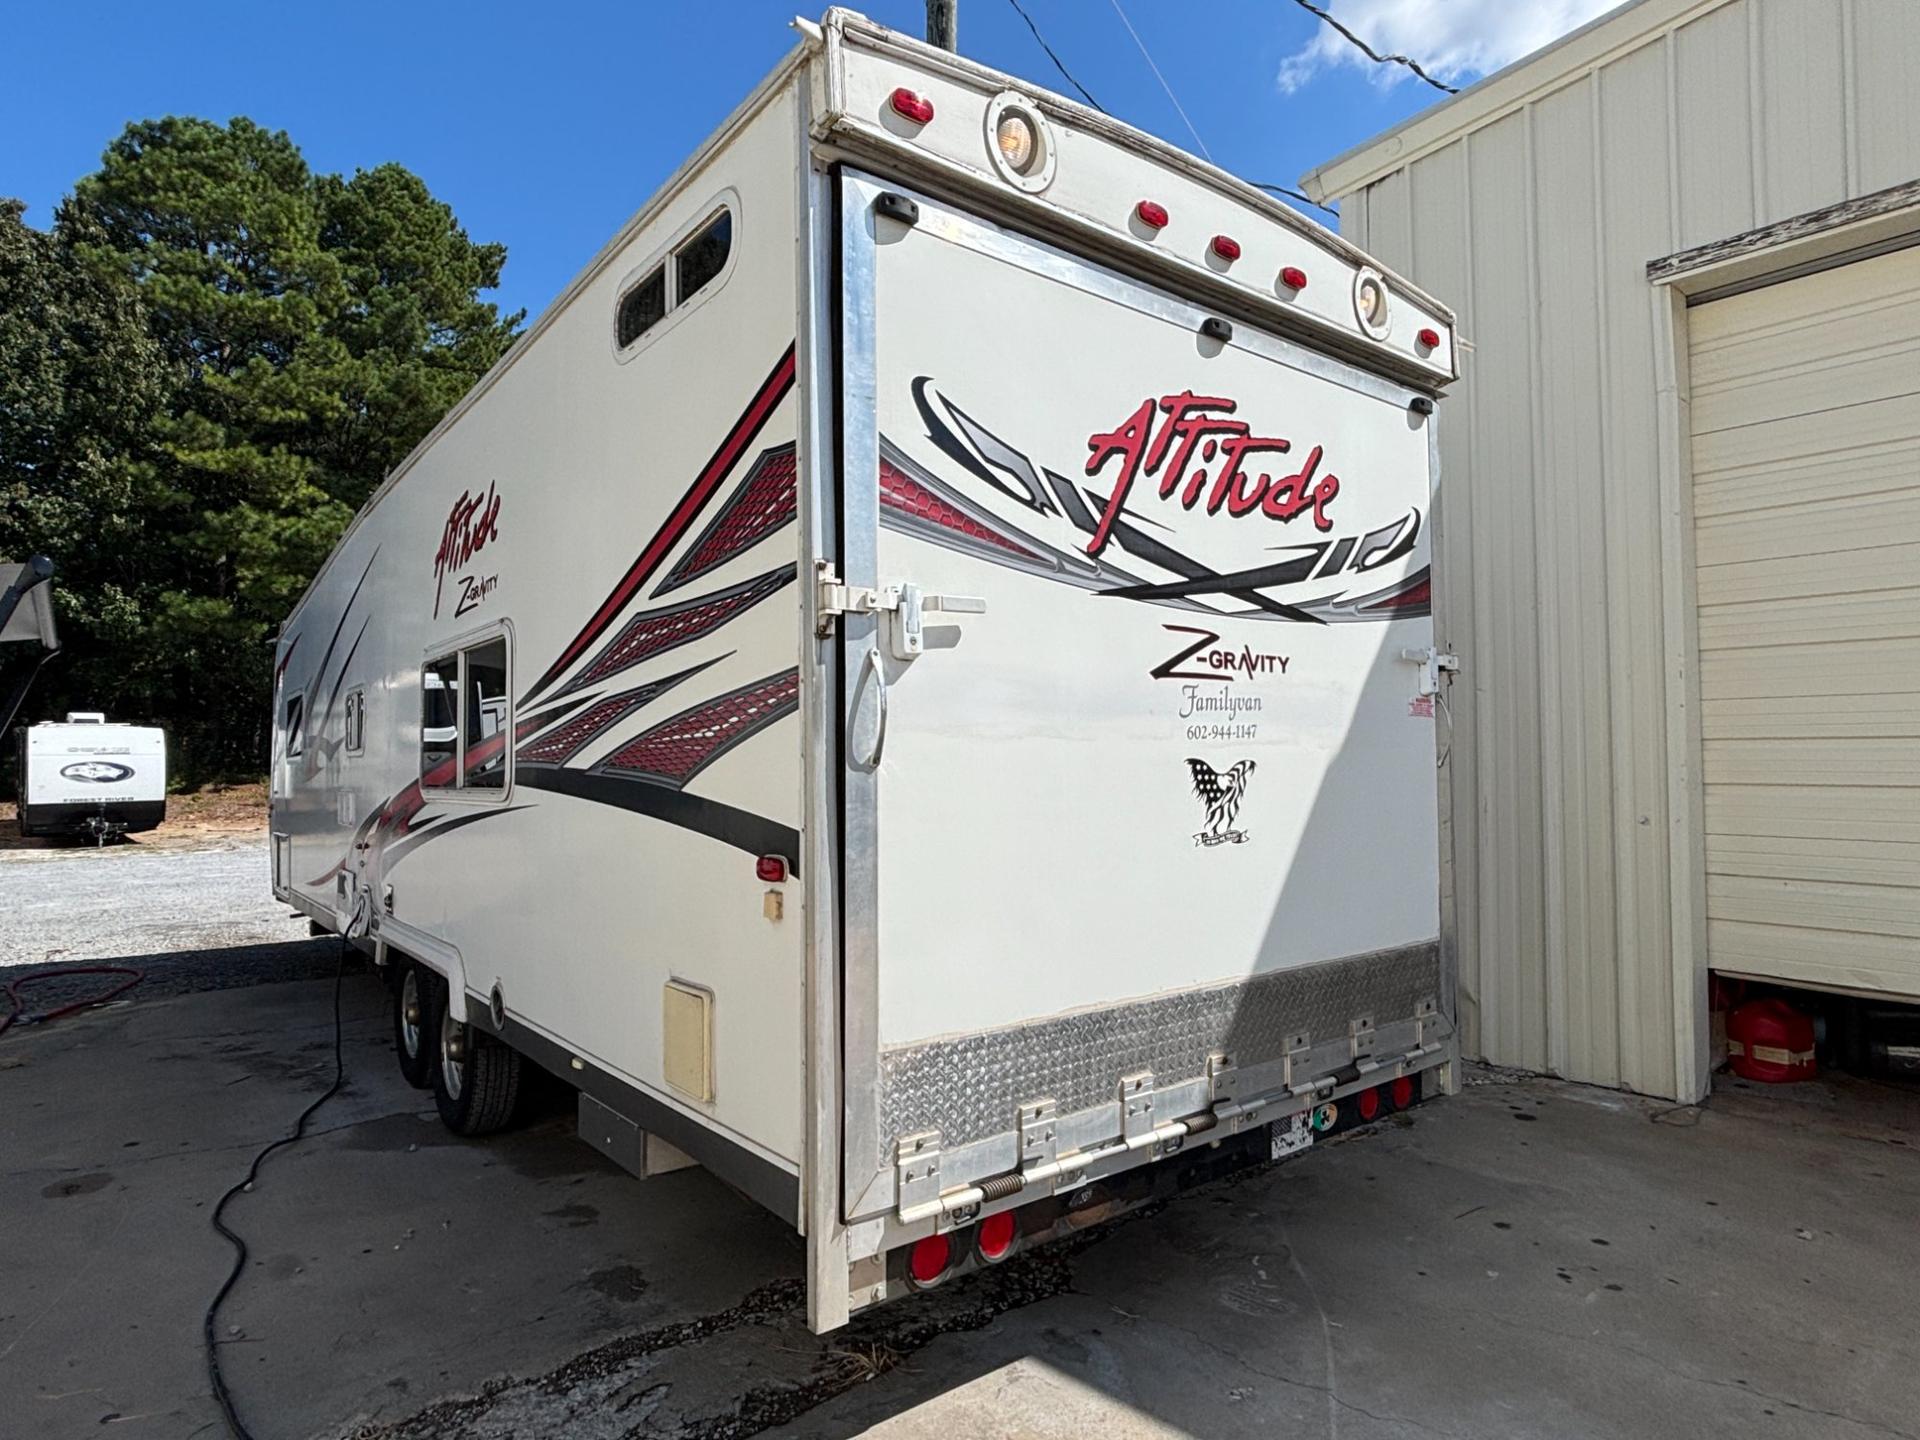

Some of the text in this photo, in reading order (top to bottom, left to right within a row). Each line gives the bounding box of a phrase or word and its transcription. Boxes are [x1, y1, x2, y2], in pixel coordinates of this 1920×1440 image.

[1149, 624, 1290, 681] Z-GRAVITY
[1179, 684, 1262, 721] Familyvan
[1186, 724, 1257, 740] 602-944-1147
